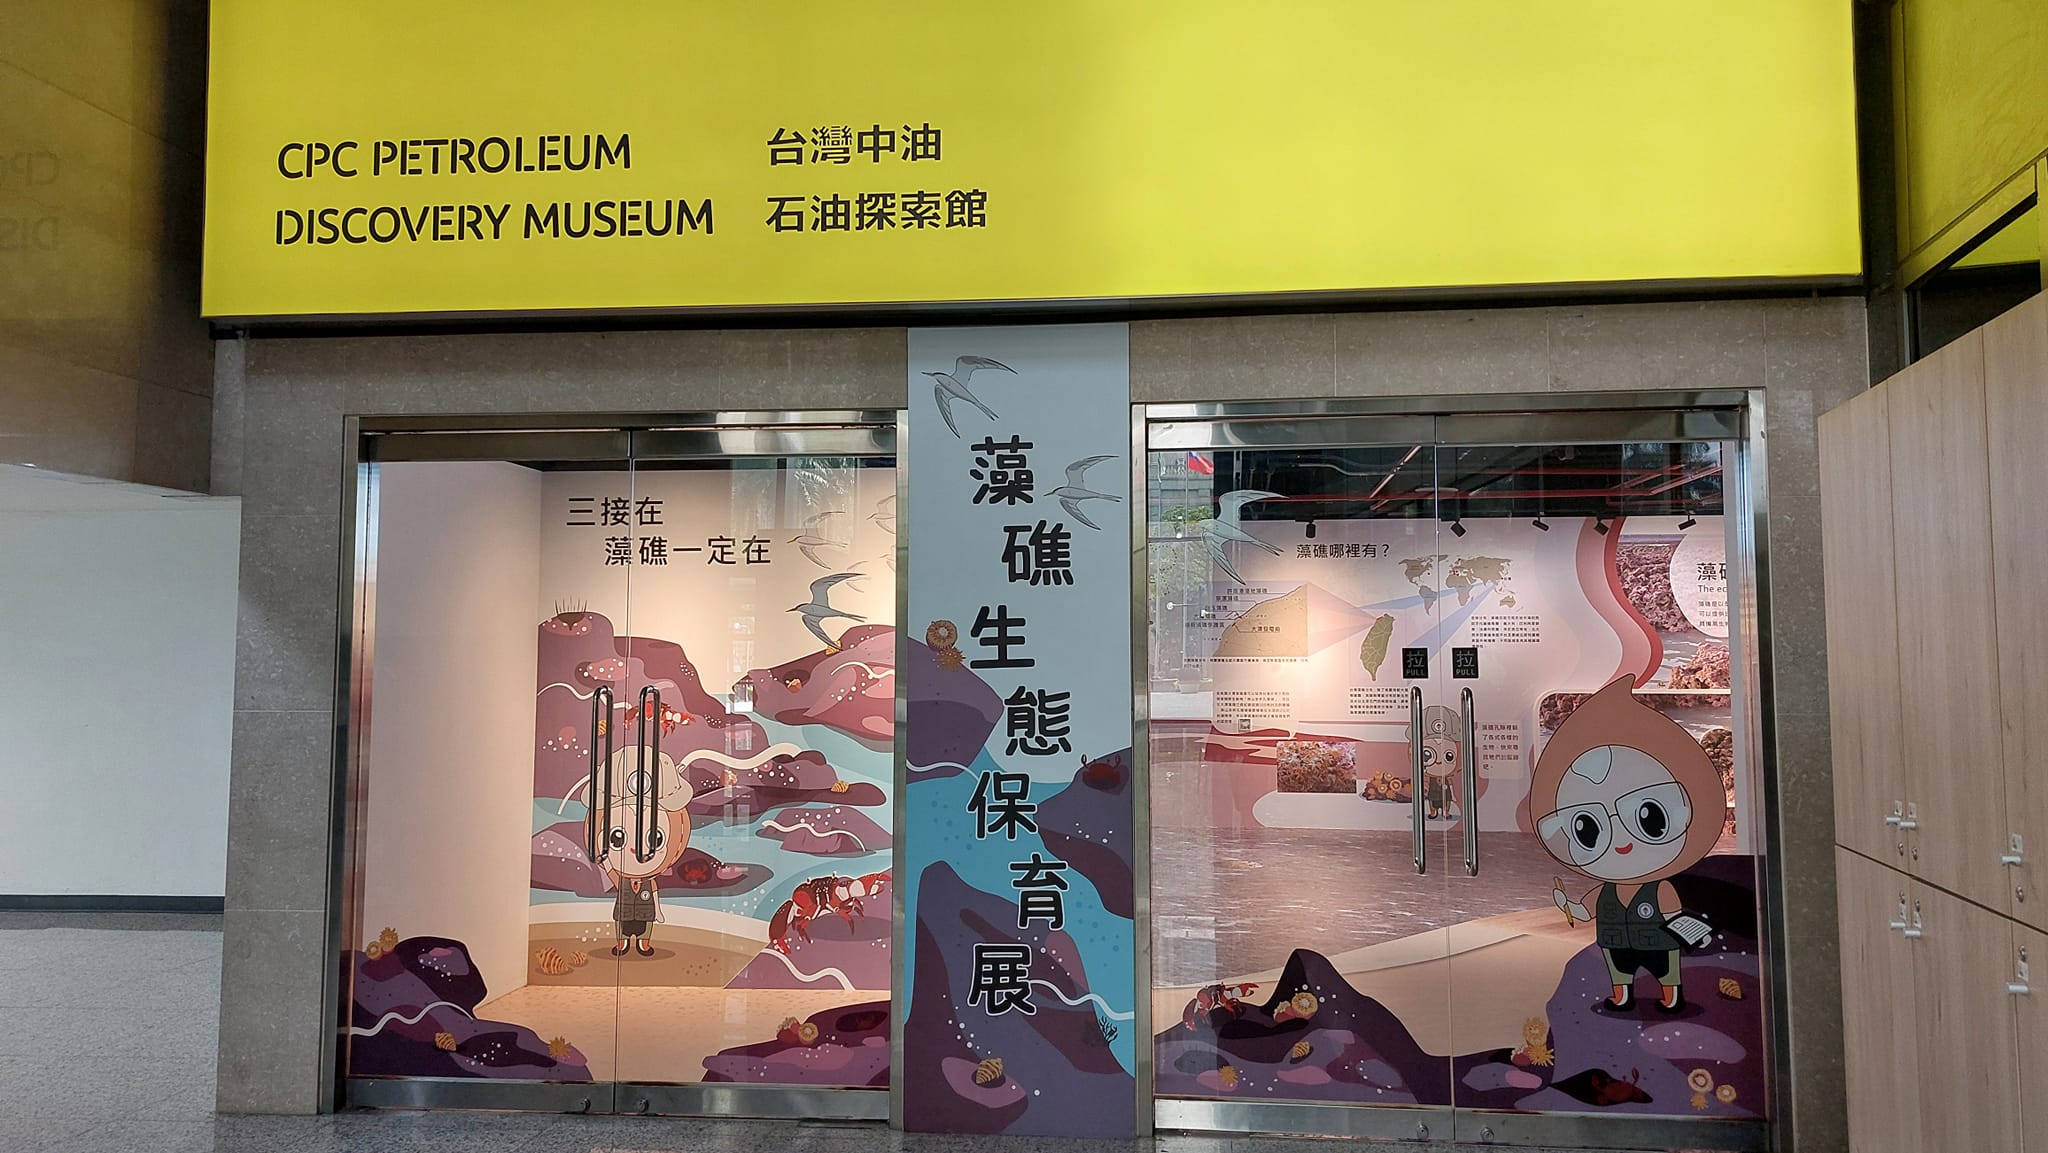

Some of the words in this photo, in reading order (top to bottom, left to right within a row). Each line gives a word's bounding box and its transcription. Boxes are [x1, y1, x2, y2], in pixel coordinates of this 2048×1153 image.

[278, 142, 357, 179] CPC
[372, 134, 632, 177] PETROLEUM
[766, 123, 942, 168] 台灣中油
[275, 203, 512, 246] DISCOVERY
[523, 199, 714, 239] MUSEUM
[765, 189, 989, 233] 石油探索館
[566, 496, 664, 527] 三接在
[604, 535, 772, 567] 藻礁一定在
[1697, 584, 1715, 593] The
[1406, 650, 1424, 668] 拉
[1406, 668, 1425, 676] PULL
[1455, 668, 1475, 676] PULL
[1456, 650, 1475, 668] 拉
[967, 434, 1074, 1016] 藻礁生態保育展
